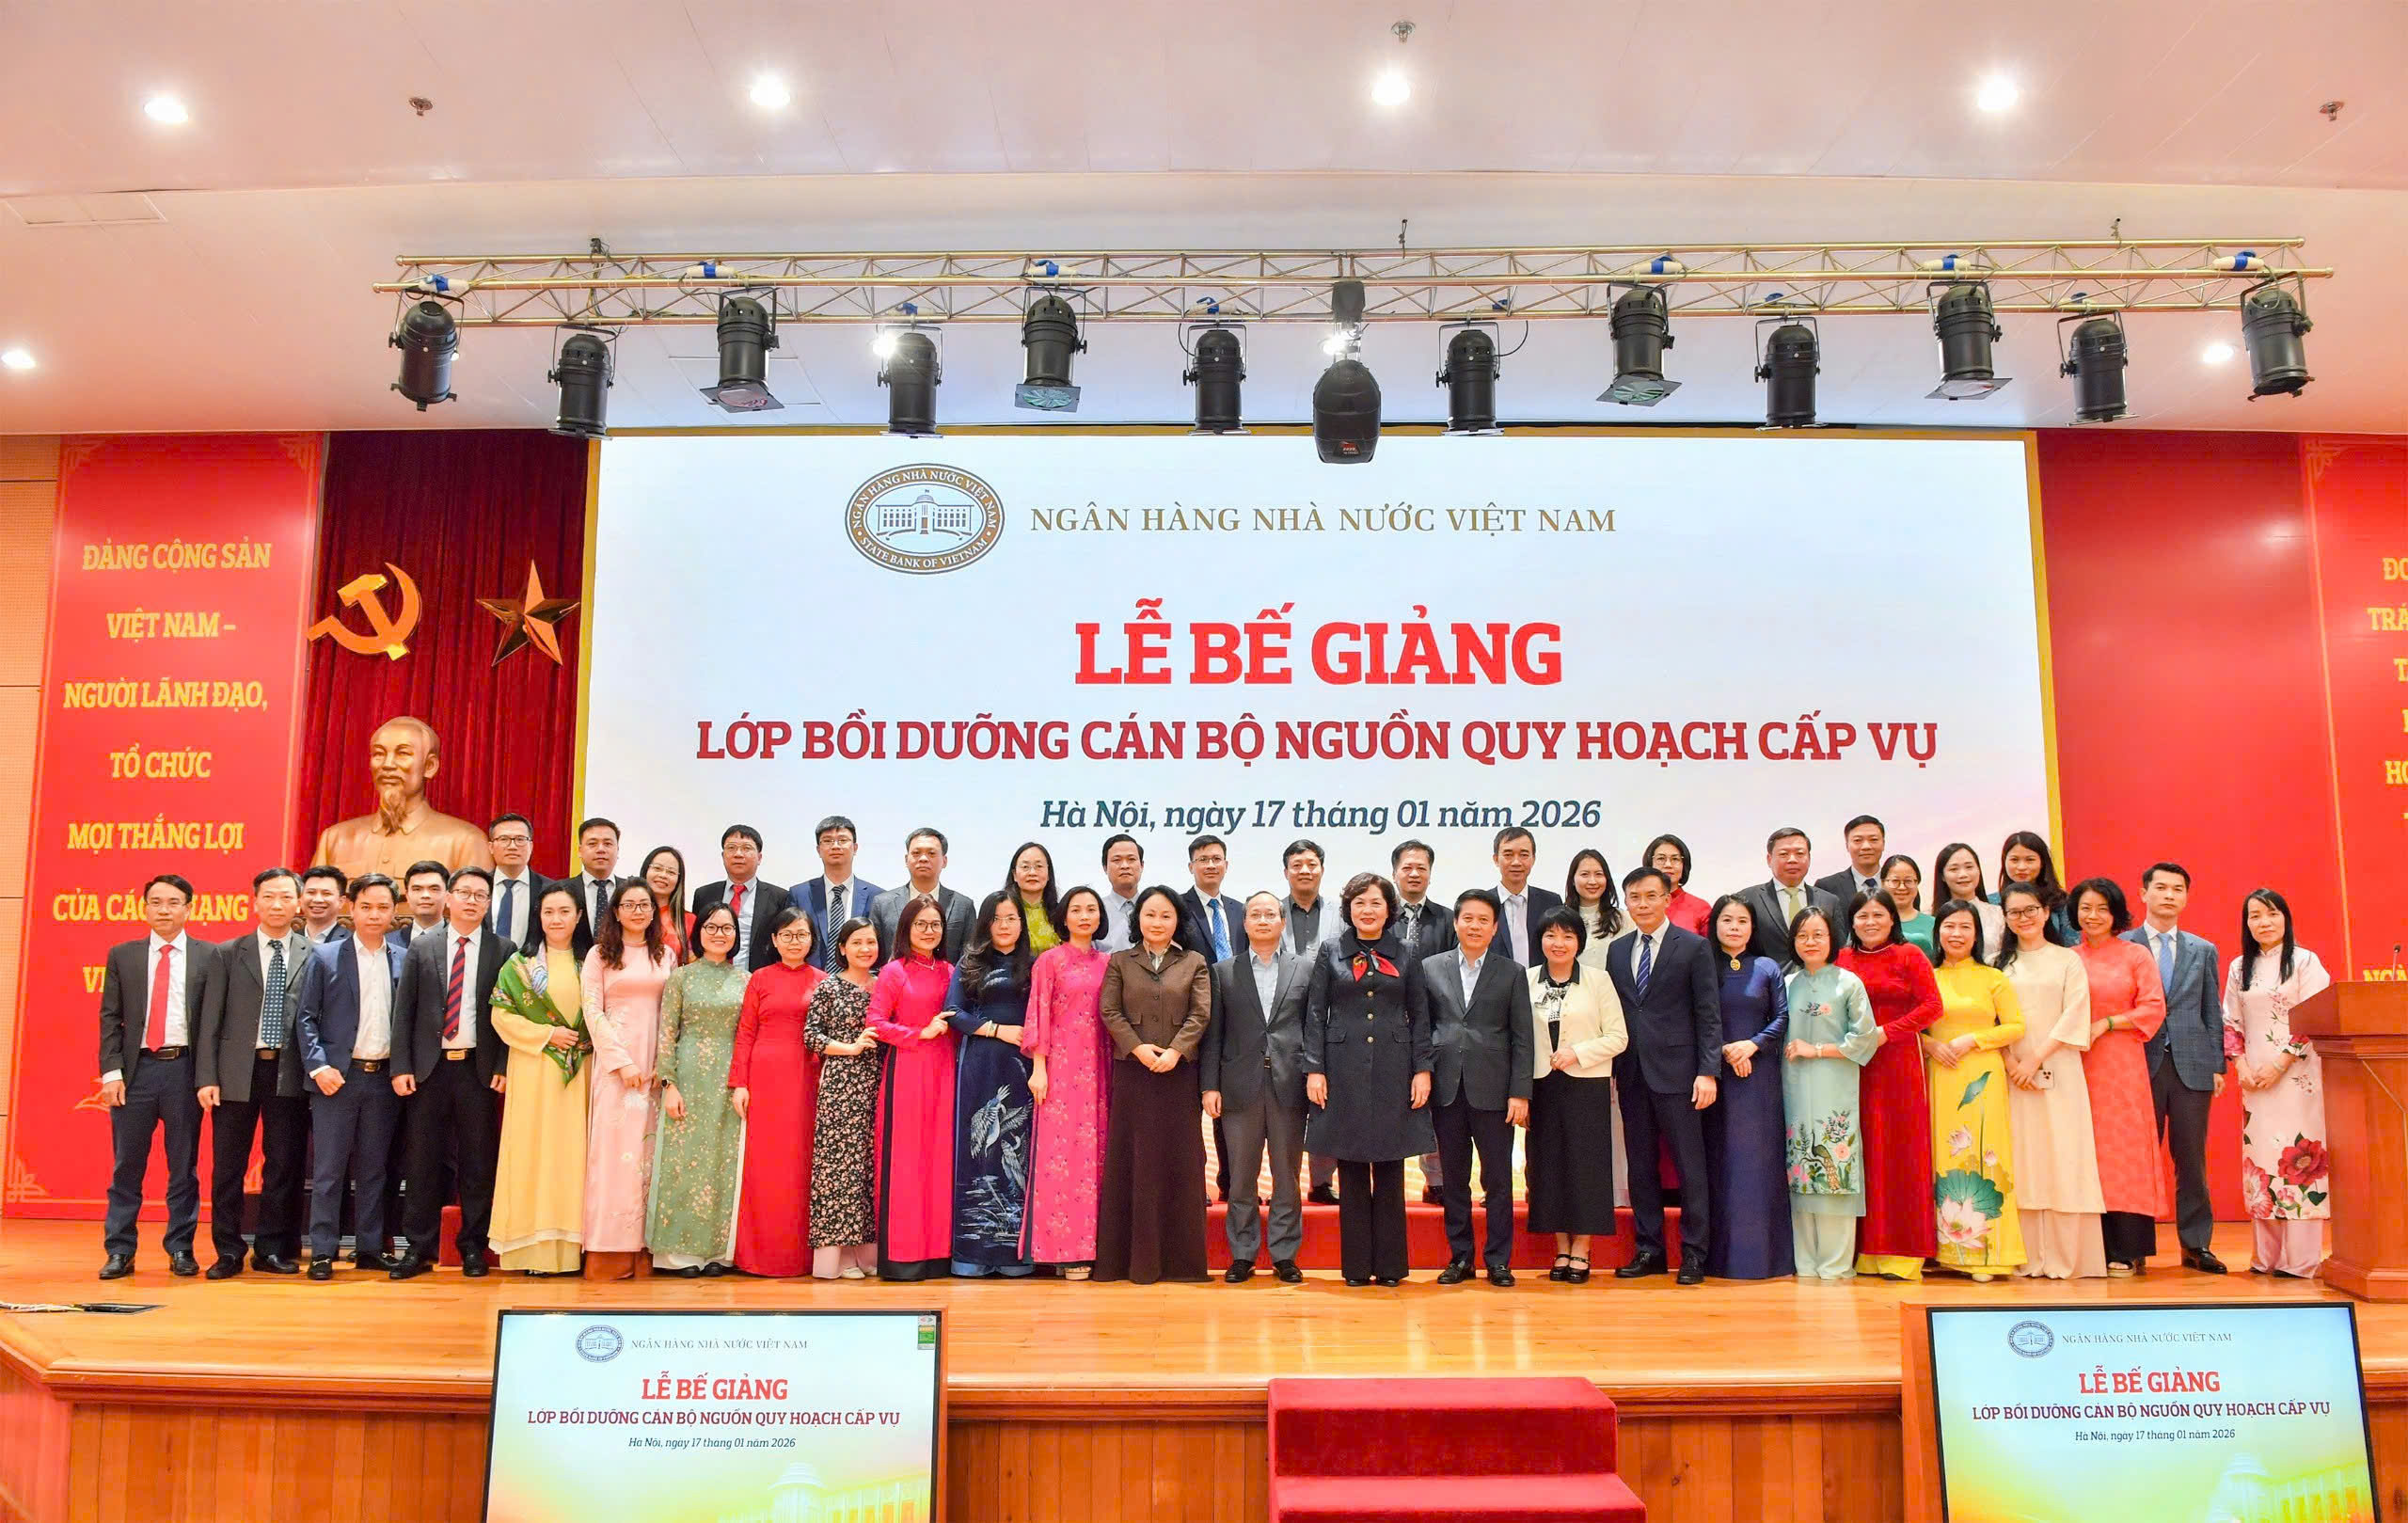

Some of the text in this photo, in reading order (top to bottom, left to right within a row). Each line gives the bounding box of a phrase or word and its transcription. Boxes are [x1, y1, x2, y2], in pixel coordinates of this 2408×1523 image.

[852, 469, 997, 529] NGÂN HÀNG NHÀ NƯỚC VIỆT NAM
[1031, 500, 1616, 537] NGÂN HÀNG NHÀ NƯỚC VIỆT NAM
[83, 535, 272, 573] ĐẢNG CỘNG SẢN
[860, 536, 989, 568] STATE BANK OF VIETNAM
[106, 607, 160, 643] VIỆT
[163, 611, 220, 638] NAM
[1075, 598, 1561, 686] LỄ BẾ GIẢNG
[63, 676, 268, 712] NGƯỜI LÃNH ĐẠO,
[697, 708, 1938, 769] LỚP BỒI DƯỠNG CÁN BỘ NGUỒN QUY HOẠCH CẤP VỤ
[110, 742, 212, 778] TỔ CHỨC
[68, 813, 245, 855] MỌI THẮNG LỢI
[1040, 800, 1602, 835] Hà Nội, ngày 17 tháng 01 năm 2026
[53, 887, 101, 921] CỦA
[642, 1371, 788, 1400] LỄ BẾ GIẢNG
[2079, 1365, 2221, 1393] LỄ BẾ GIẢNG
[528, 1407, 900, 1428] LỚP BỒI DƯỠNG CÁN BỘ NGUỒN QUY HOẠCH CẤP VỤ
[1972, 1399, 2330, 1420] LỚP BỒI DƯỠNG CÁN BỘ NGUỒN QUY HOẠCH CẤP VỤ
